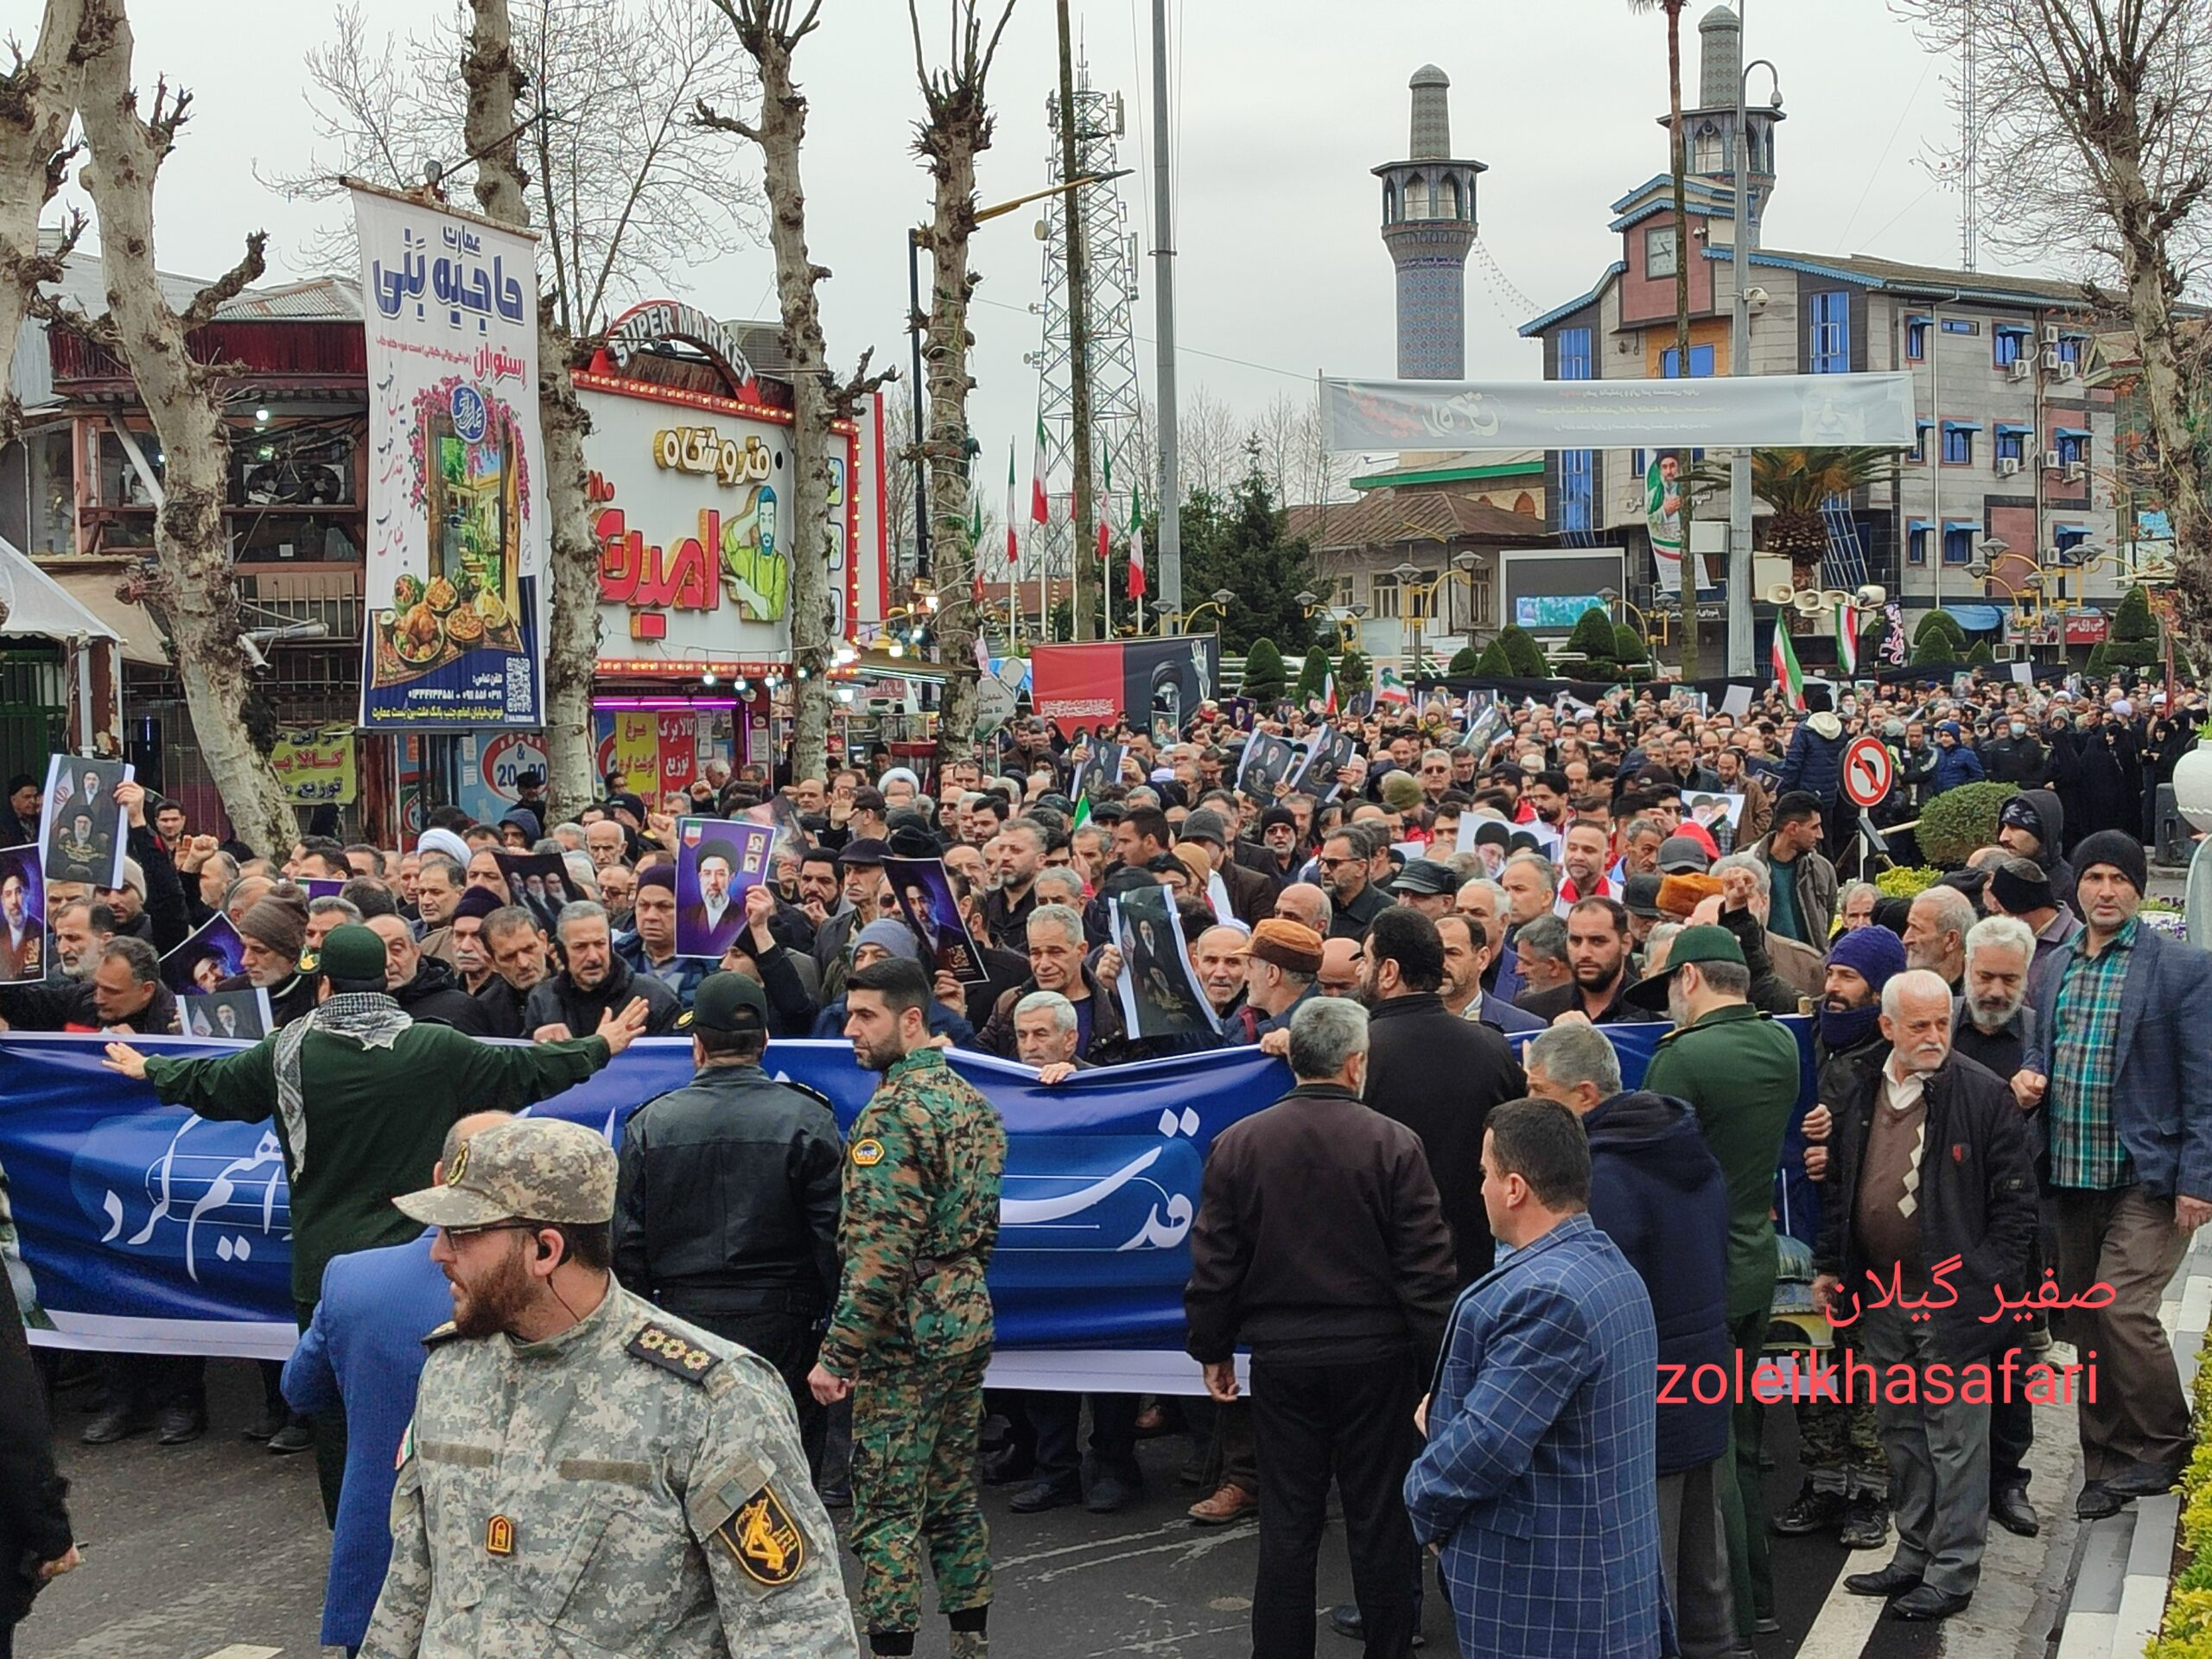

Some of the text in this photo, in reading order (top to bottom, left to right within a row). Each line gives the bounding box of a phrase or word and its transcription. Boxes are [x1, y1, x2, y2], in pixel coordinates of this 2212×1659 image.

[442, 225, 480, 253] عمارت
[432, 255, 524, 333] حاجیه
[612, 302, 757, 386] SUPER MARKET
[474, 343, 526, 385] رستوران
[654, 428, 772, 486] فروشگاه
[296, 748, 346, 769] کالا
[665, 751, 690, 777] توزیع
[296, 777, 344, 799] توزیع
